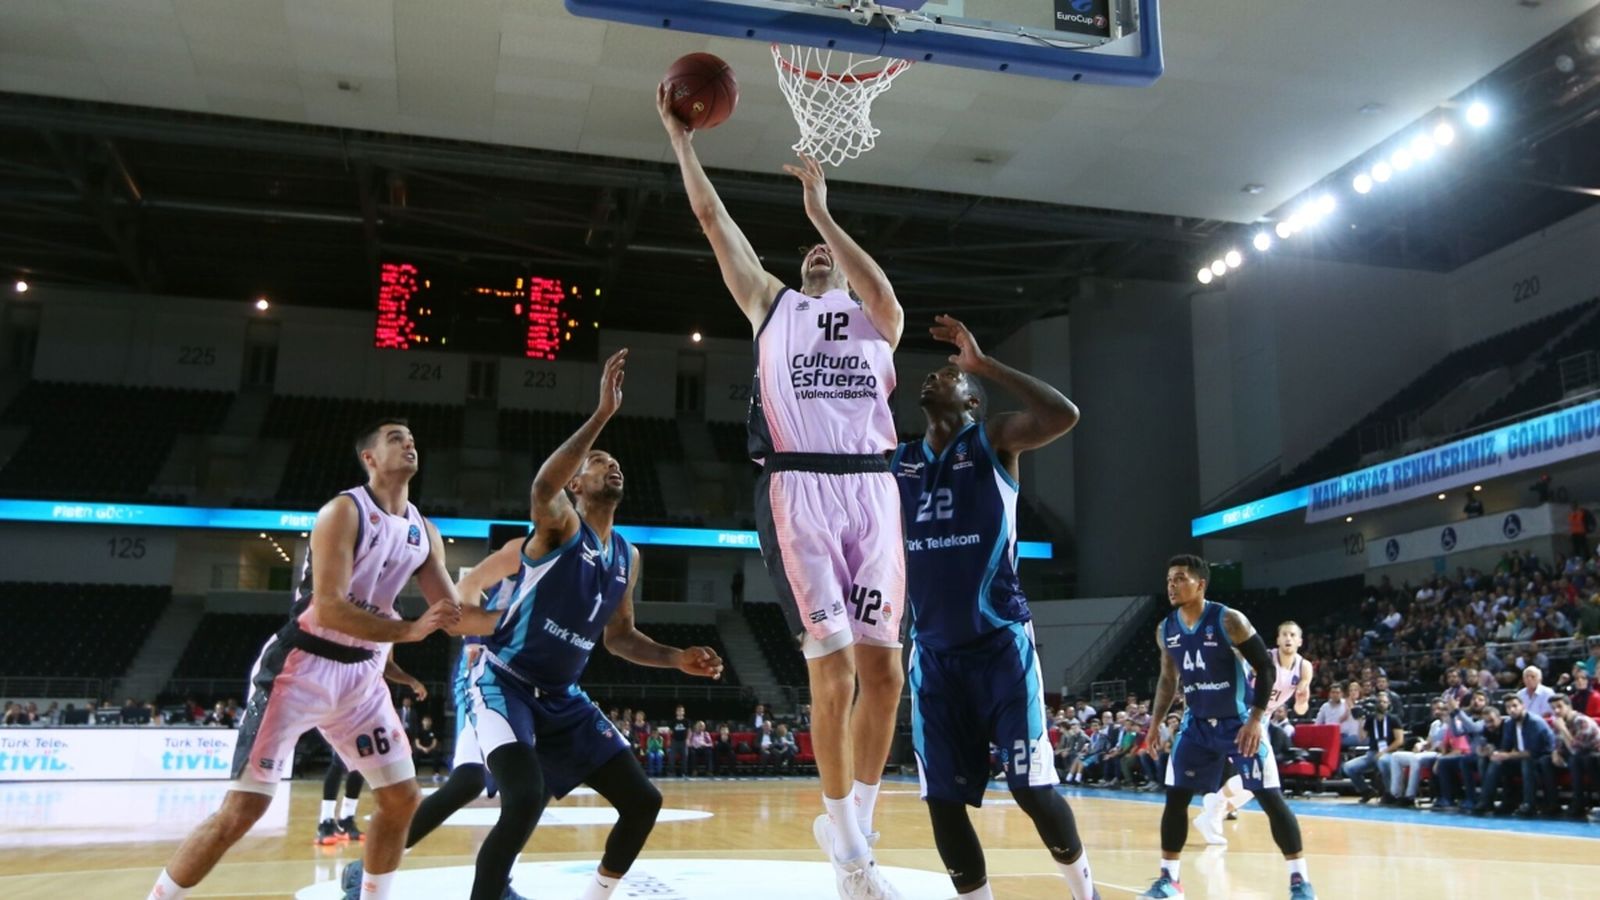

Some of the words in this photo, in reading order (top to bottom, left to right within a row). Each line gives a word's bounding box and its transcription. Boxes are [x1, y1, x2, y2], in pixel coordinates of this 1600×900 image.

[1056, 11, 1093, 25] EuroCup
[1512, 275, 1540, 304] 220
[817, 312, 849, 341] 42
[178, 346, 217, 366] 225
[792, 352, 860, 370] Cultura
[408, 363, 442, 381] 224
[524, 370, 557, 388] 223
[791, 368, 878, 389] Esfuerzo
[729, 384, 752, 401] 22
[915, 488, 954, 522] 22
[108, 536, 147, 559] 125
[925, 534, 981, 549] Telekom
[1342, 532, 1365, 556] 120
[587, 592, 602, 622] 1
[850, 583, 882, 626] 42
[543, 618, 571, 641] Türk
[1183, 649, 1206, 671] 44
